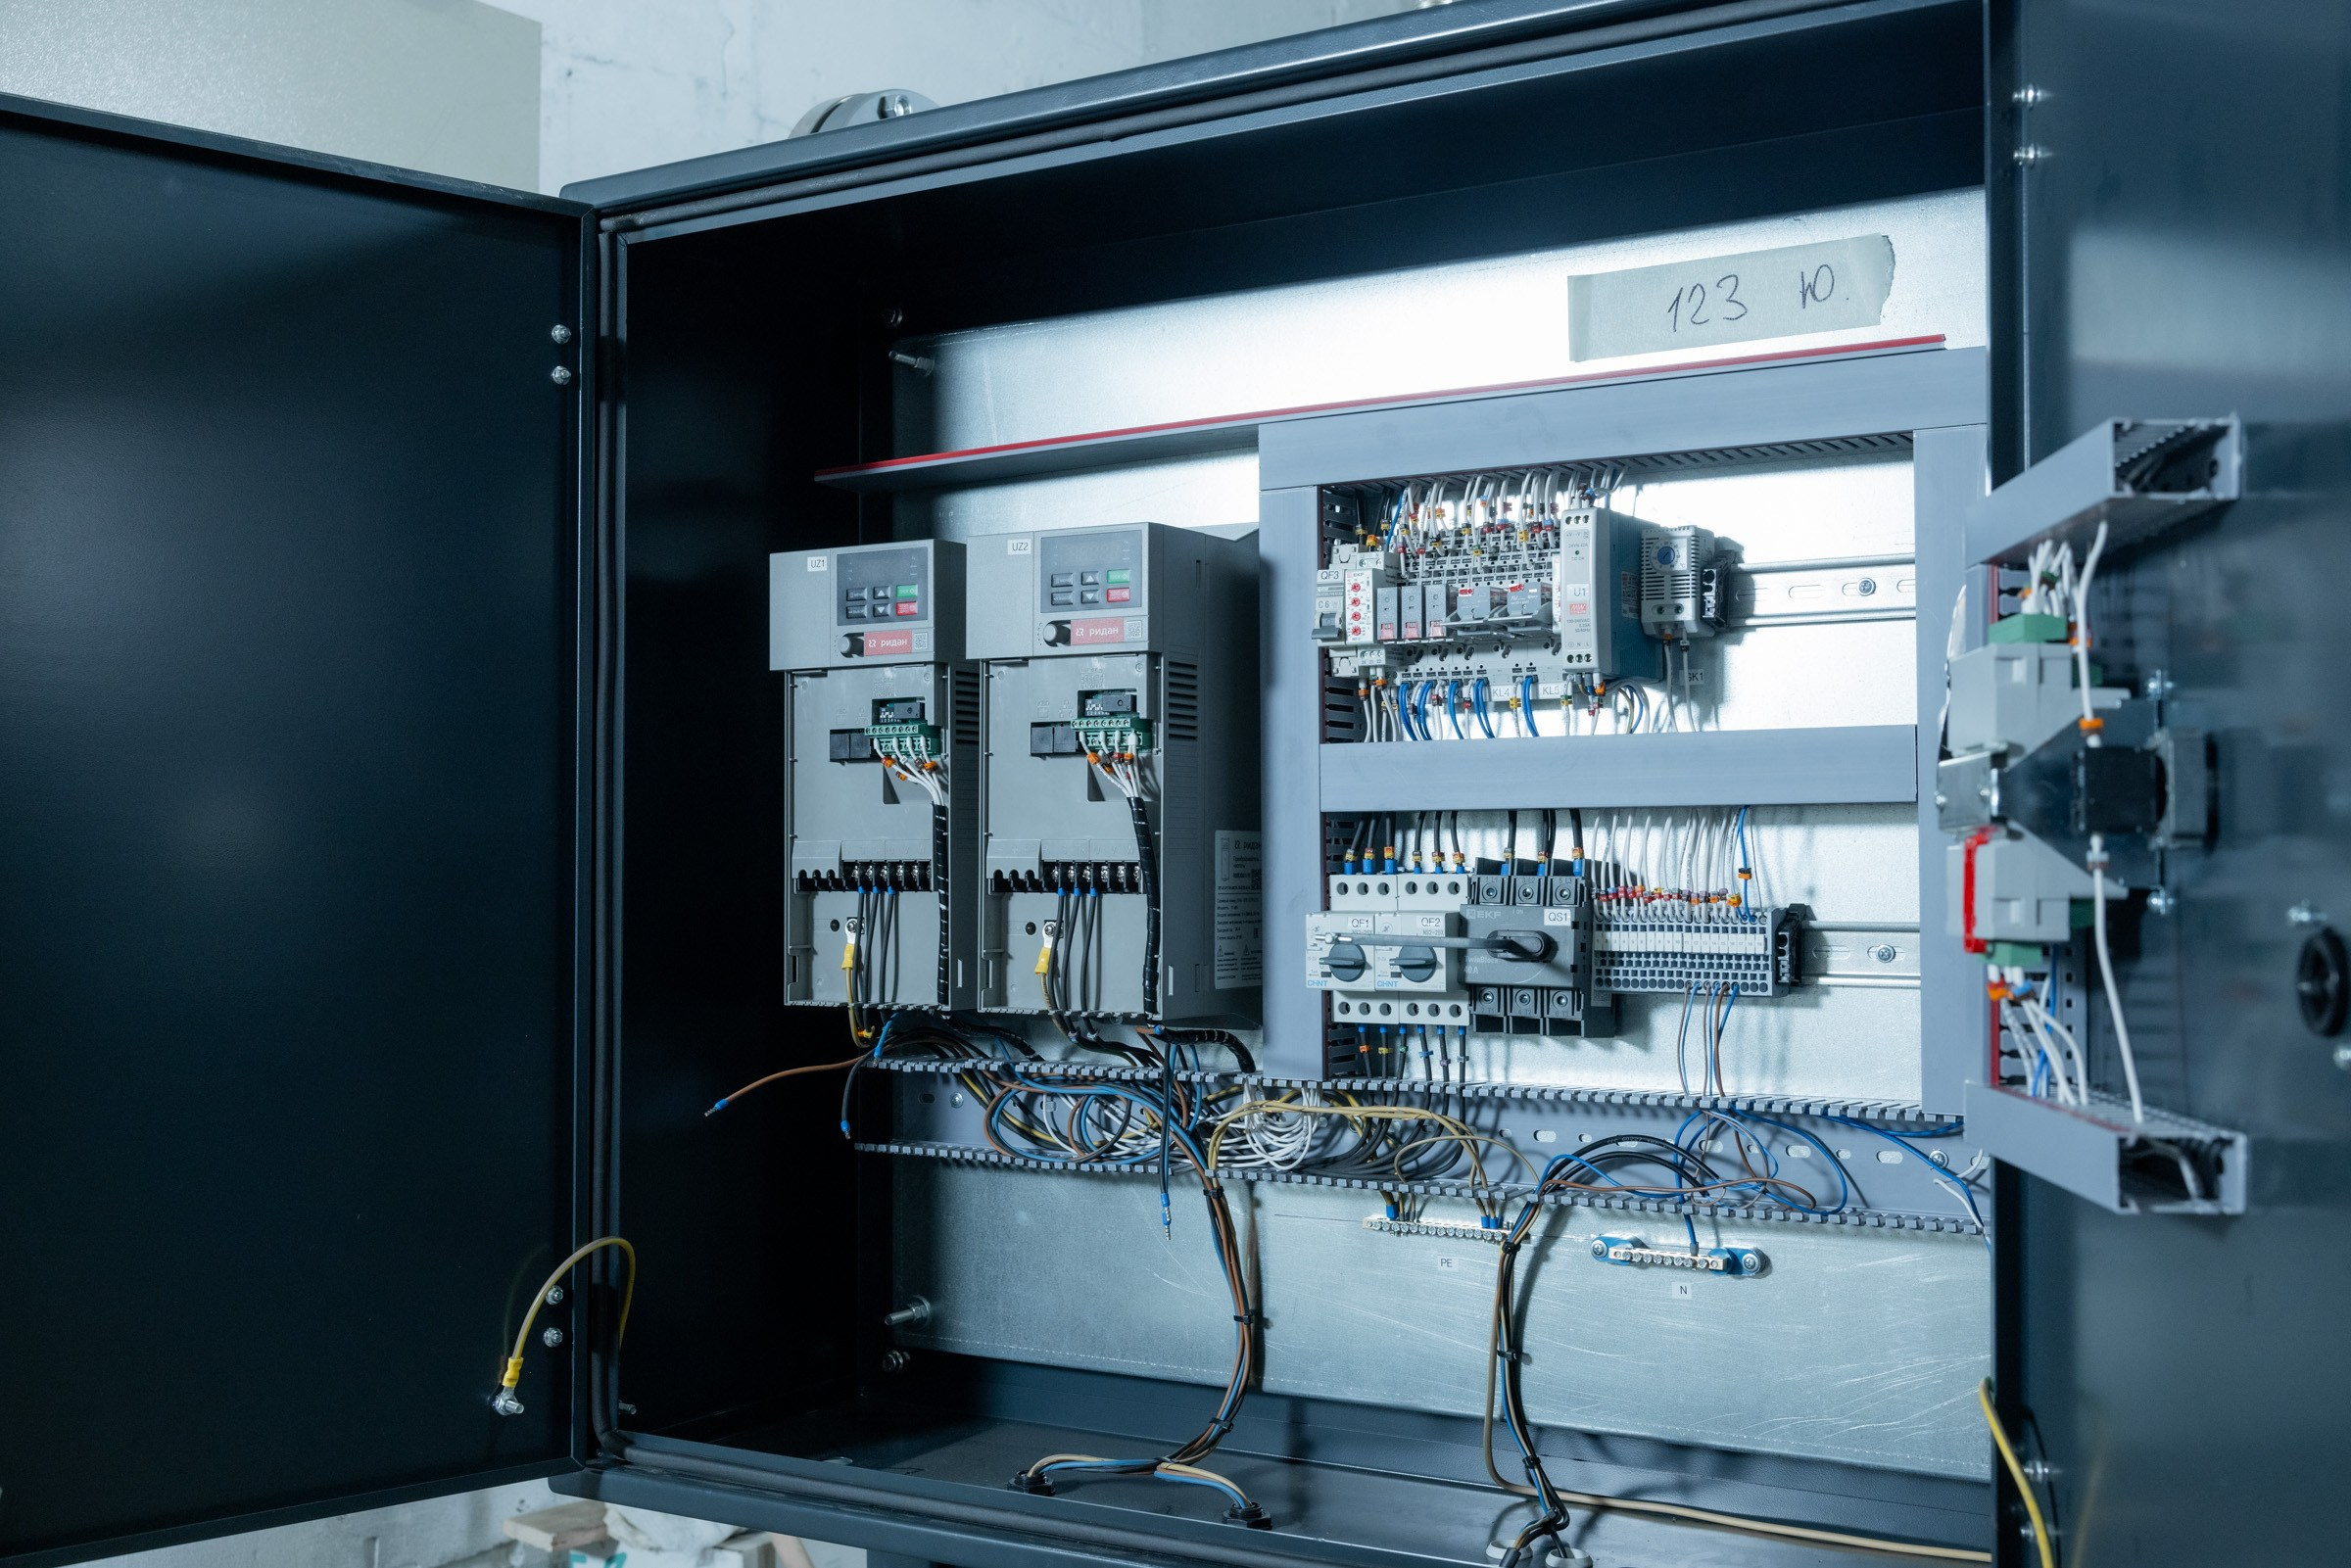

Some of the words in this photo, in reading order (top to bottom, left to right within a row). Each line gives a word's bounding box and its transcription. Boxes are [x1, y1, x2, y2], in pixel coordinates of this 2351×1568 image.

[1667, 273, 1749, 333] 123
[1012, 543, 1029, 551] UZ2
[810, 559, 825, 568] UZ1
[1320, 570, 1339, 580] QF3
[1573, 588, 1586, 596] U1
[1089, 627, 1119, 637] ридан
[881, 639, 908, 647] ридан
[1492, 689, 1510, 697] KL4
[1542, 687, 1559, 695] KL5
[1477, 910, 1501, 919] EKF
[1548, 912, 1567, 921] QS1
[1351, 919, 1369, 927] QF1
[1421, 918, 1441, 927] QF2
[1440, 1258, 1453, 1268] PE
[1680, 1285, 1688, 1295] N
